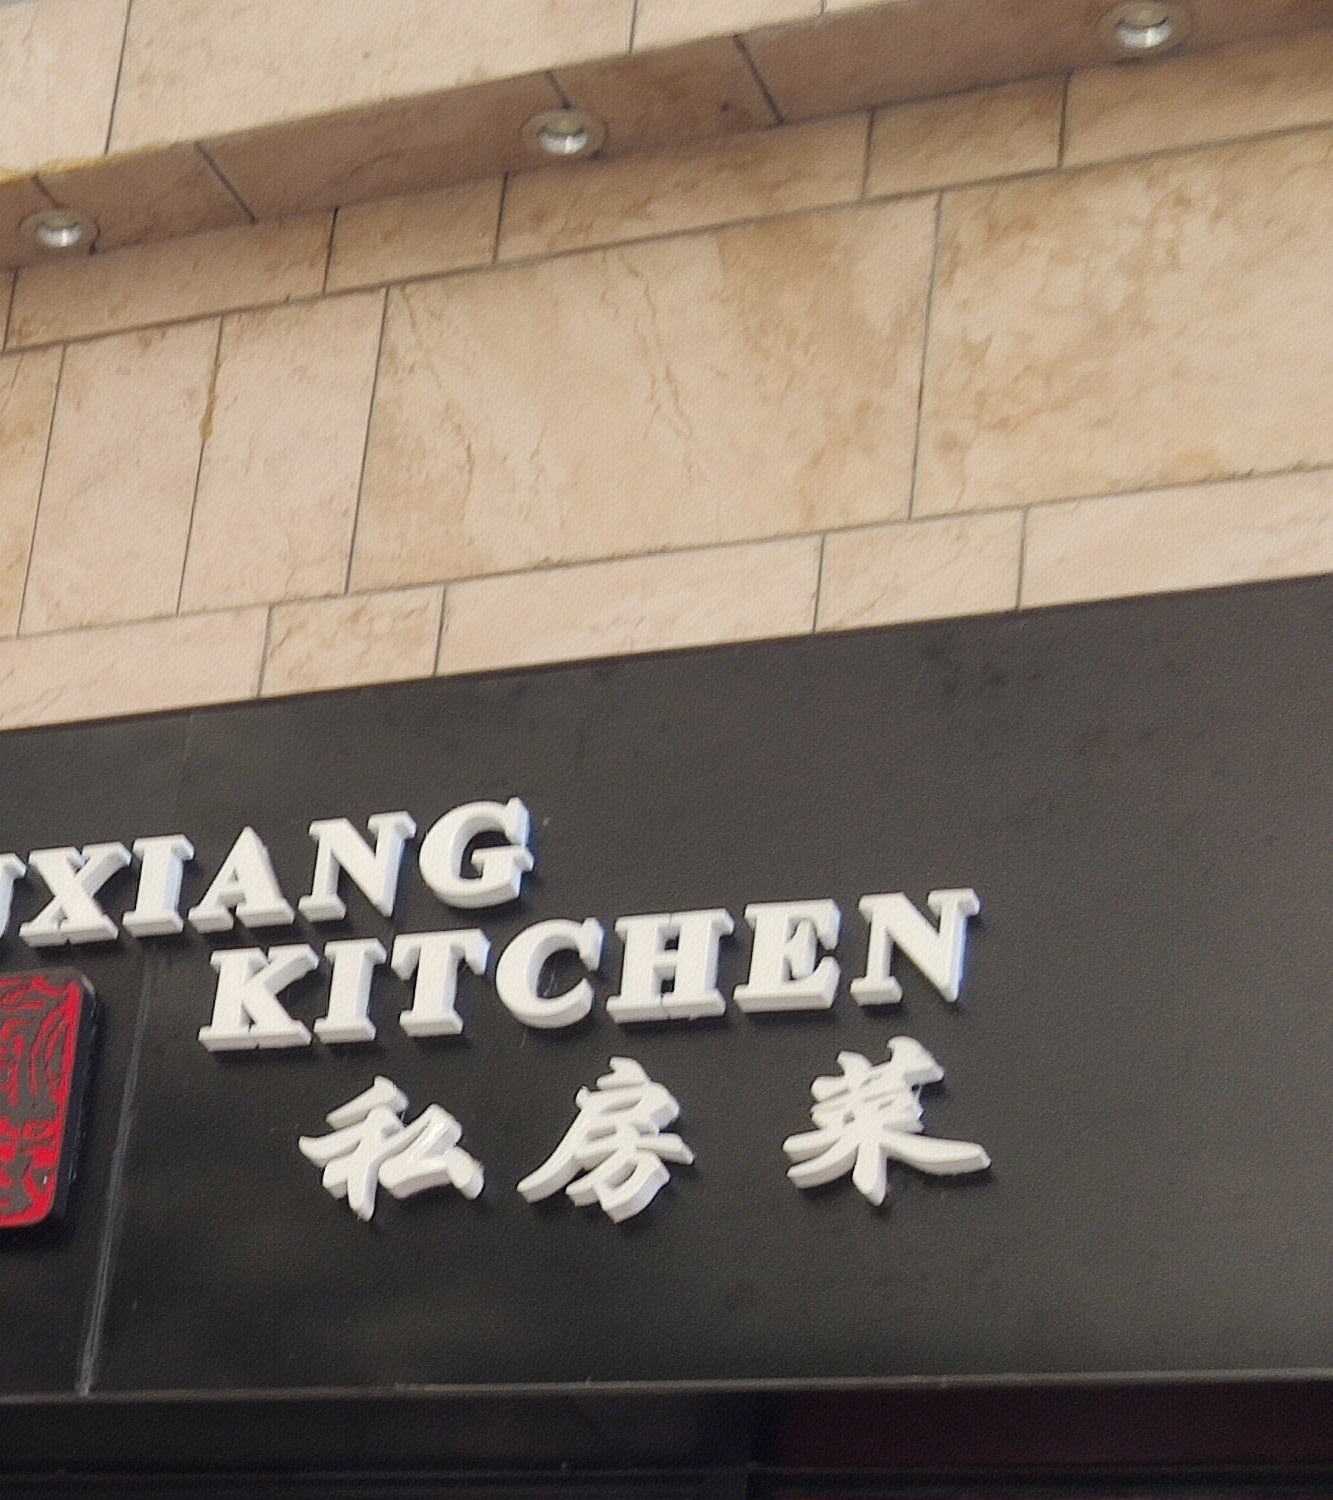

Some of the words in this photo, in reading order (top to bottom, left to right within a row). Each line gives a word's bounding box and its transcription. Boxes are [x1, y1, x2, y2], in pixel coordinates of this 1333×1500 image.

[198, 889, 981, 1051] KITCHEN
[299, 1036, 993, 1223] 私房菜
